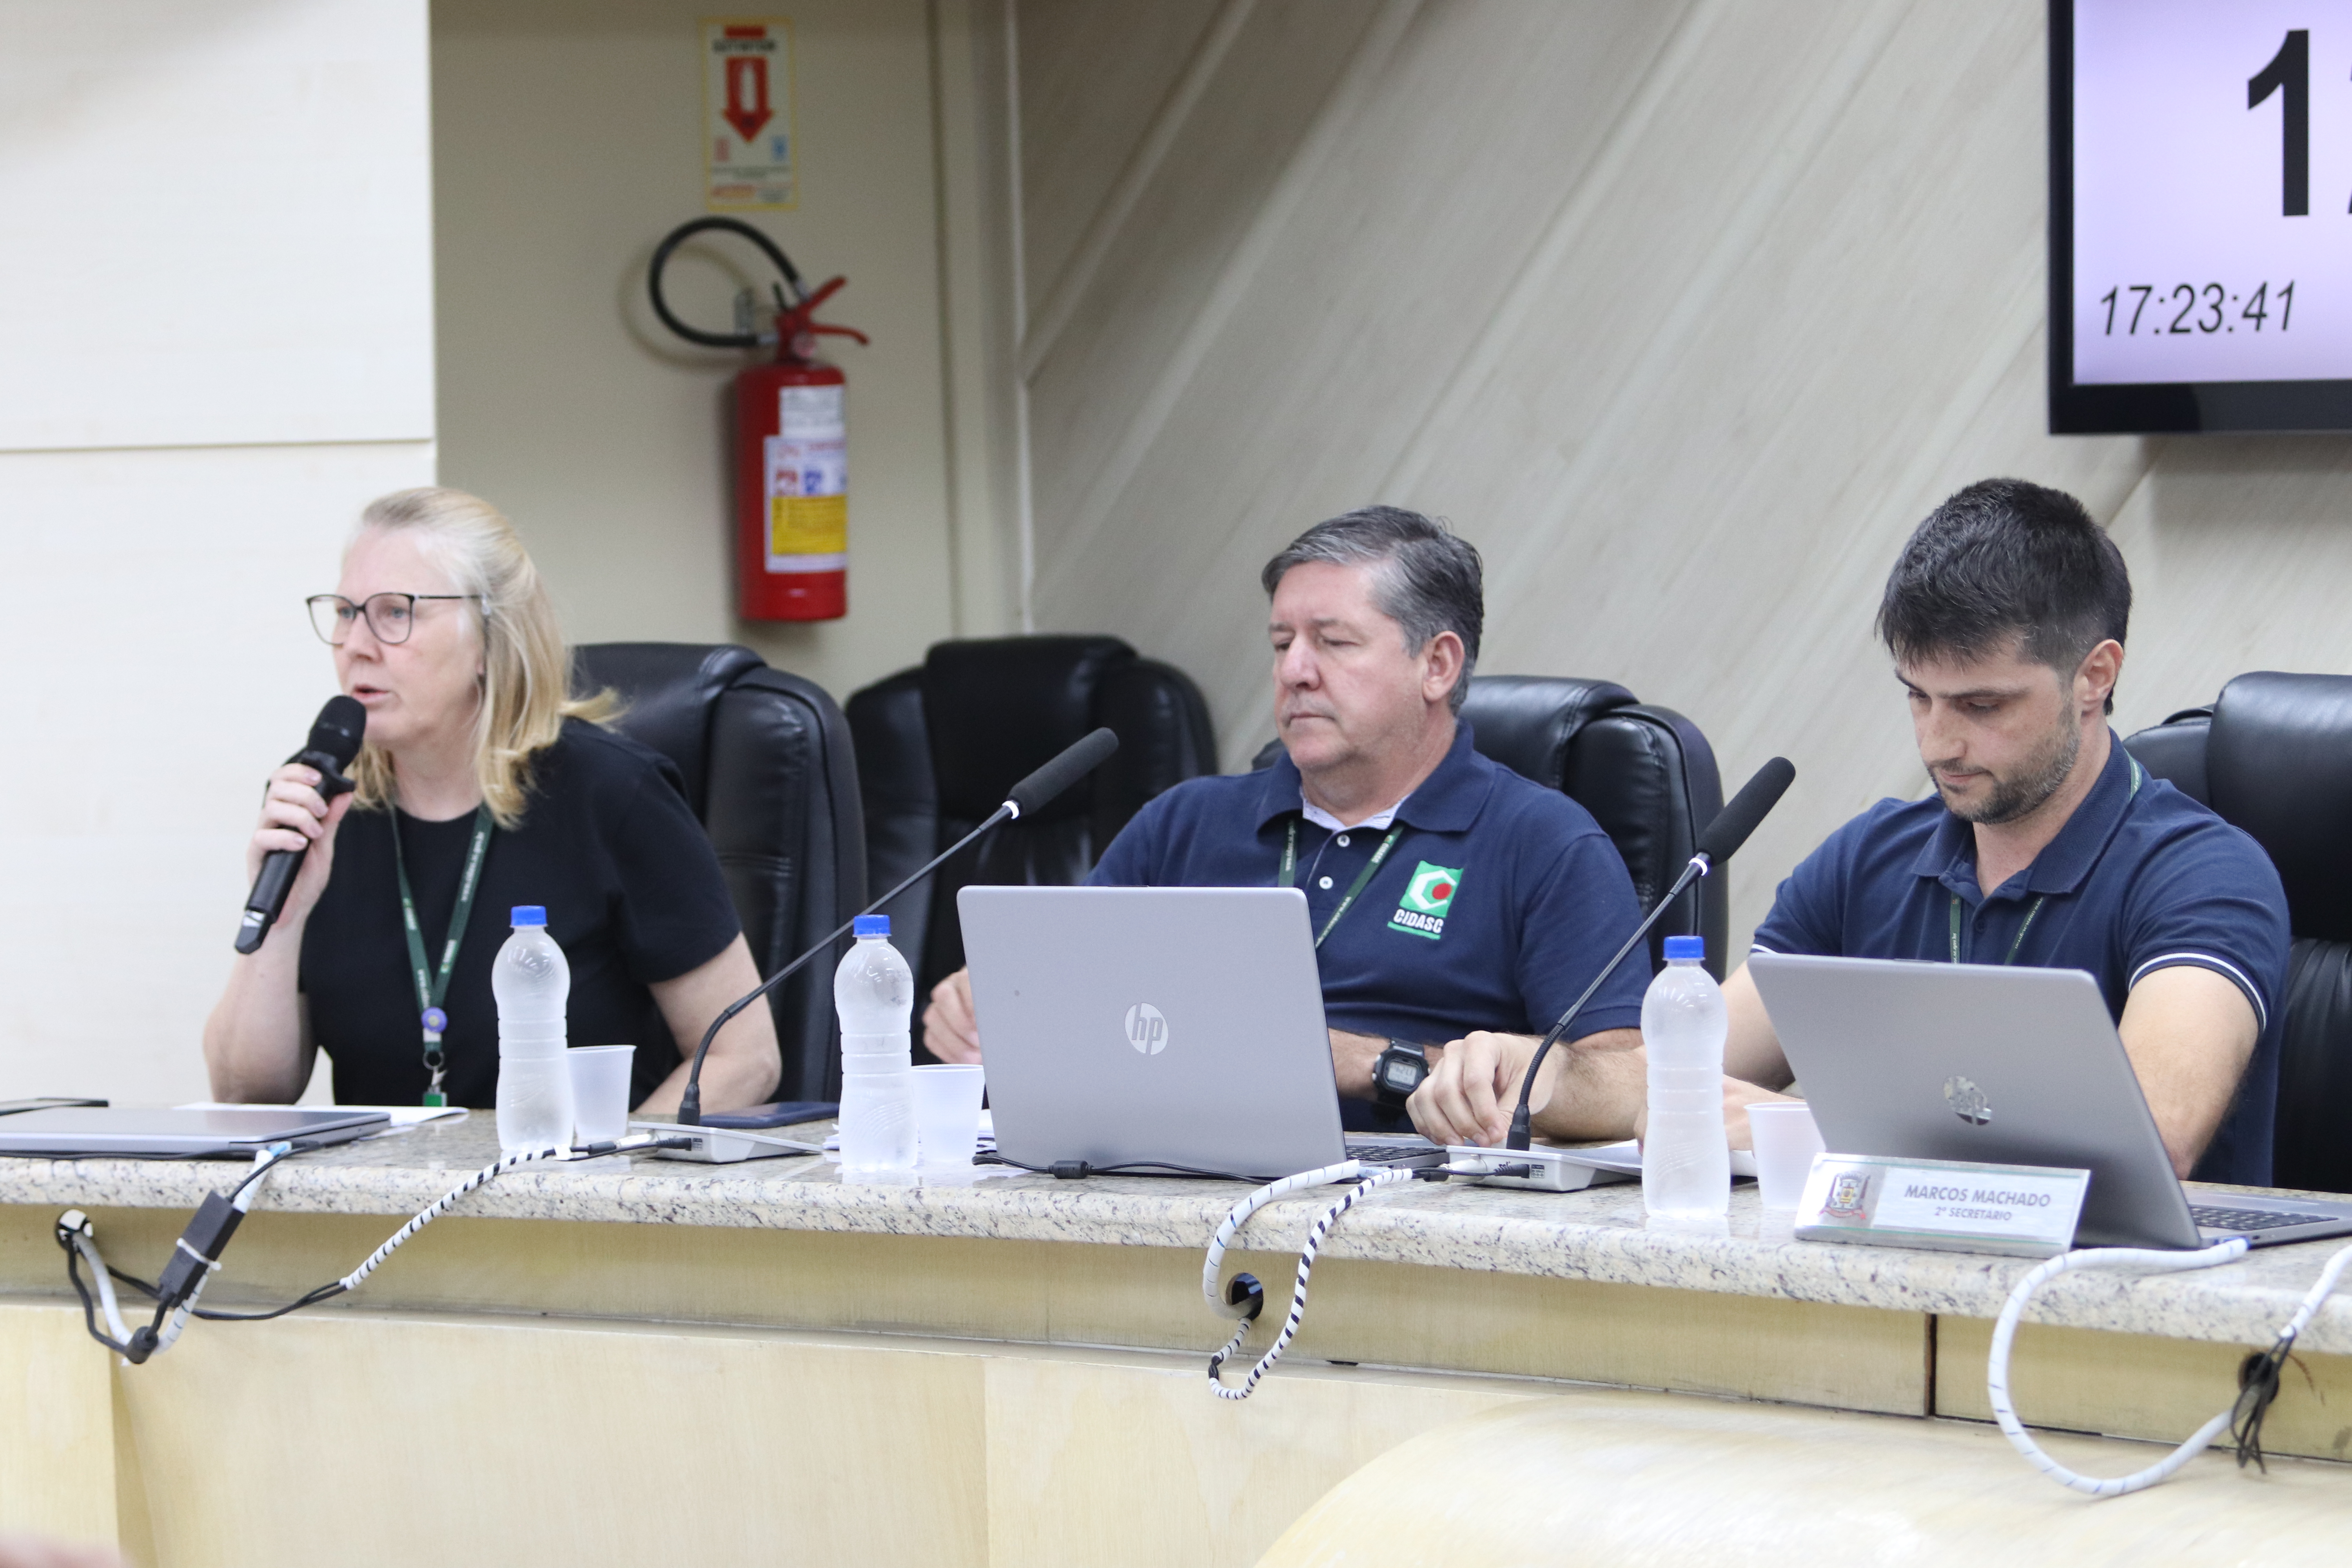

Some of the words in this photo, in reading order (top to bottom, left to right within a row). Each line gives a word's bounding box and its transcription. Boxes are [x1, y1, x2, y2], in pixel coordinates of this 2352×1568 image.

[2247, 29, 2352, 216] 1
[2100, 279, 2295, 336] 17:23:41
[1393, 909, 1444, 934] CIDASC
[1131, 1002, 1164, 1055] hp
[1904, 1185, 1967, 1202] MARCOS
[1972, 1189, 2051, 1207] MACHADO
[1949, 1207, 2012, 1221] SECRETÁRIO
